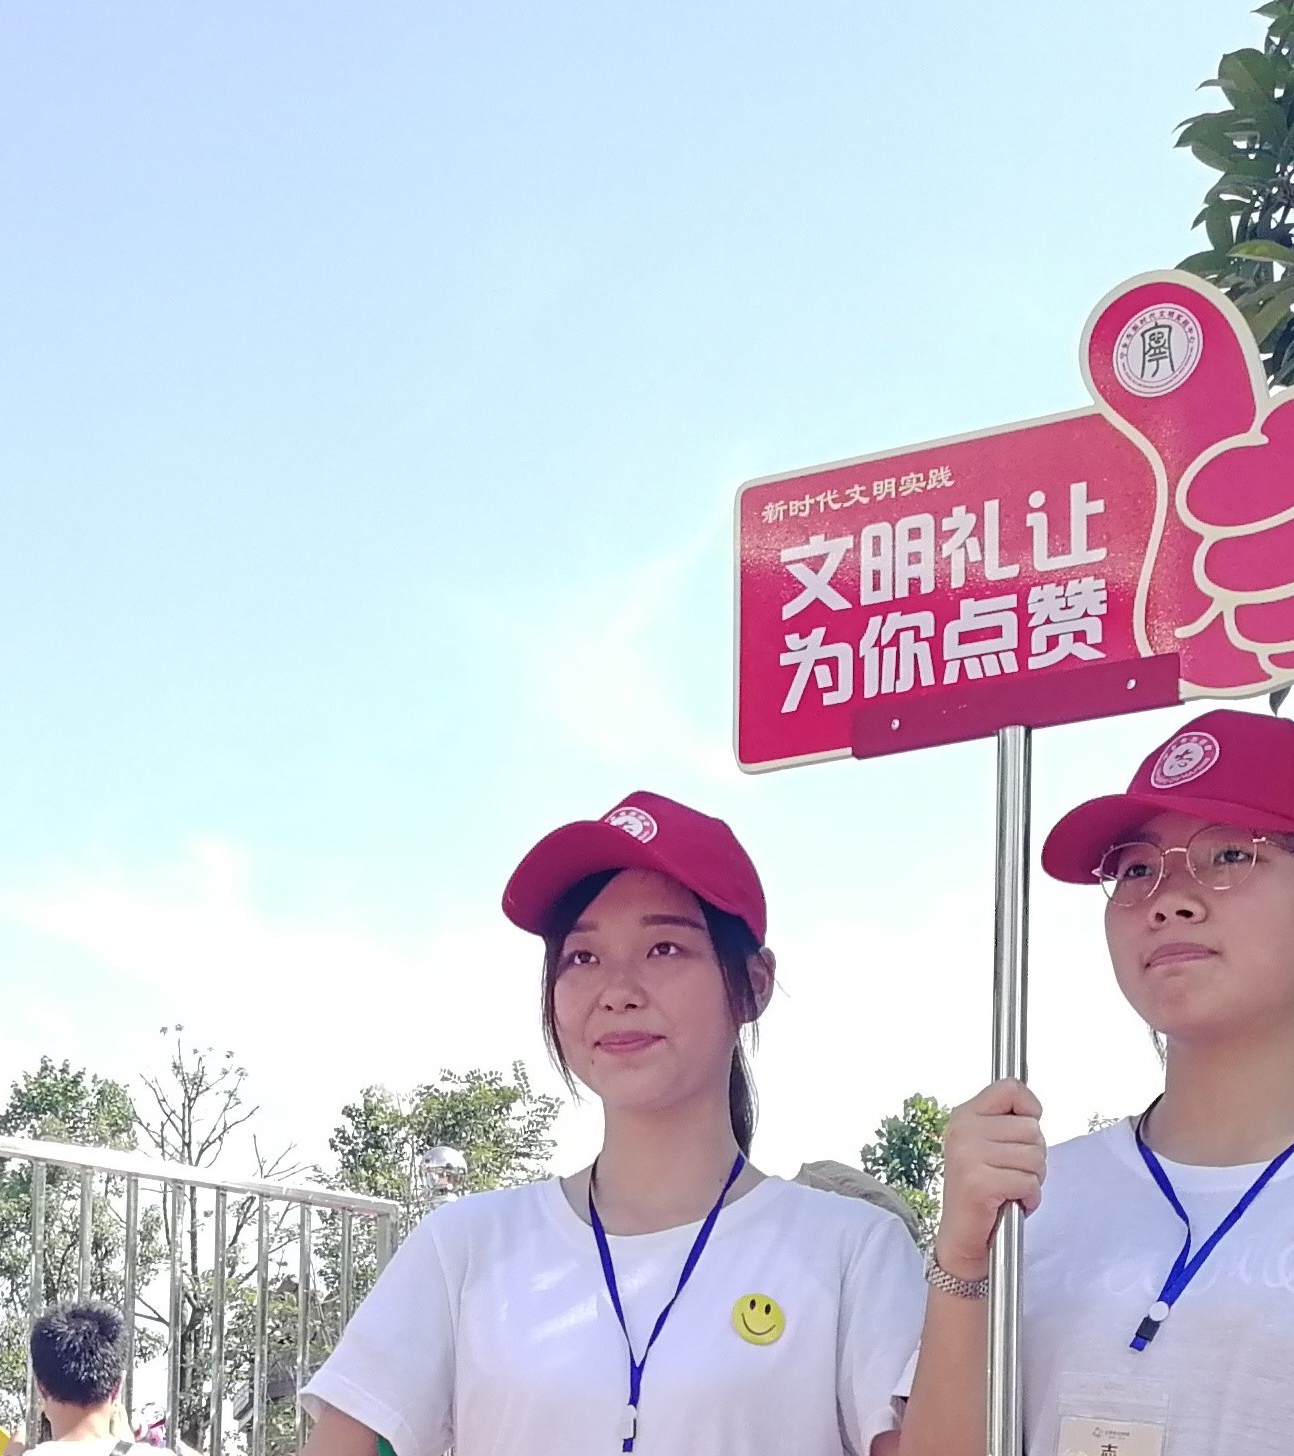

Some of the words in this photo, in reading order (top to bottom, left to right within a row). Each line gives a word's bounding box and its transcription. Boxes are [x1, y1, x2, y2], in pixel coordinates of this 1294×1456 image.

[761, 465, 955, 524] 新时代文明实践
[780, 481, 1107, 621] 文明礼让
[779, 576, 1107, 714] 为你点赞
